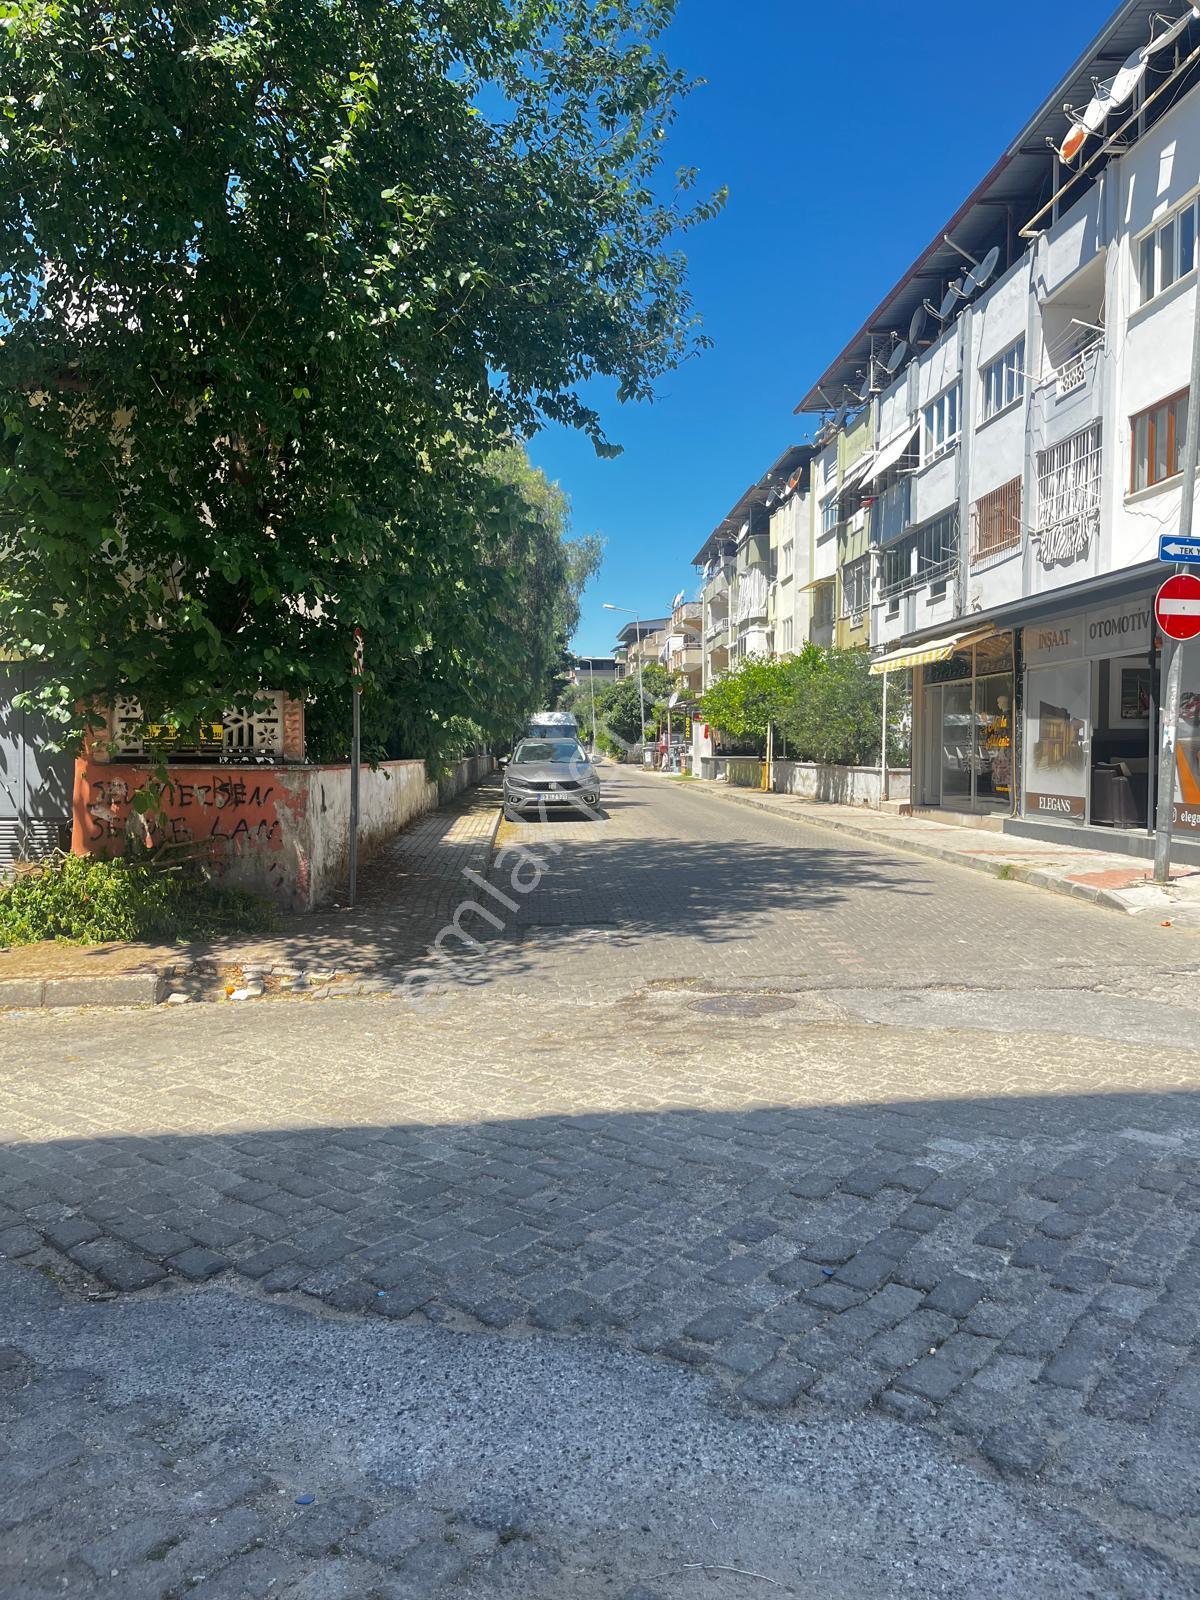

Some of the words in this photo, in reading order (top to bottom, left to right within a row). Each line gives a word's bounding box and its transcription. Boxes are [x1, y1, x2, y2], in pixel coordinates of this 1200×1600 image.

[1180, 547, 1194, 555] TEK
[1089, 608, 1151, 640] OTOMOTİV
[1039, 628, 1072, 652] İNŞAAT
[1039, 796, 1071, 812] ELEGANS
